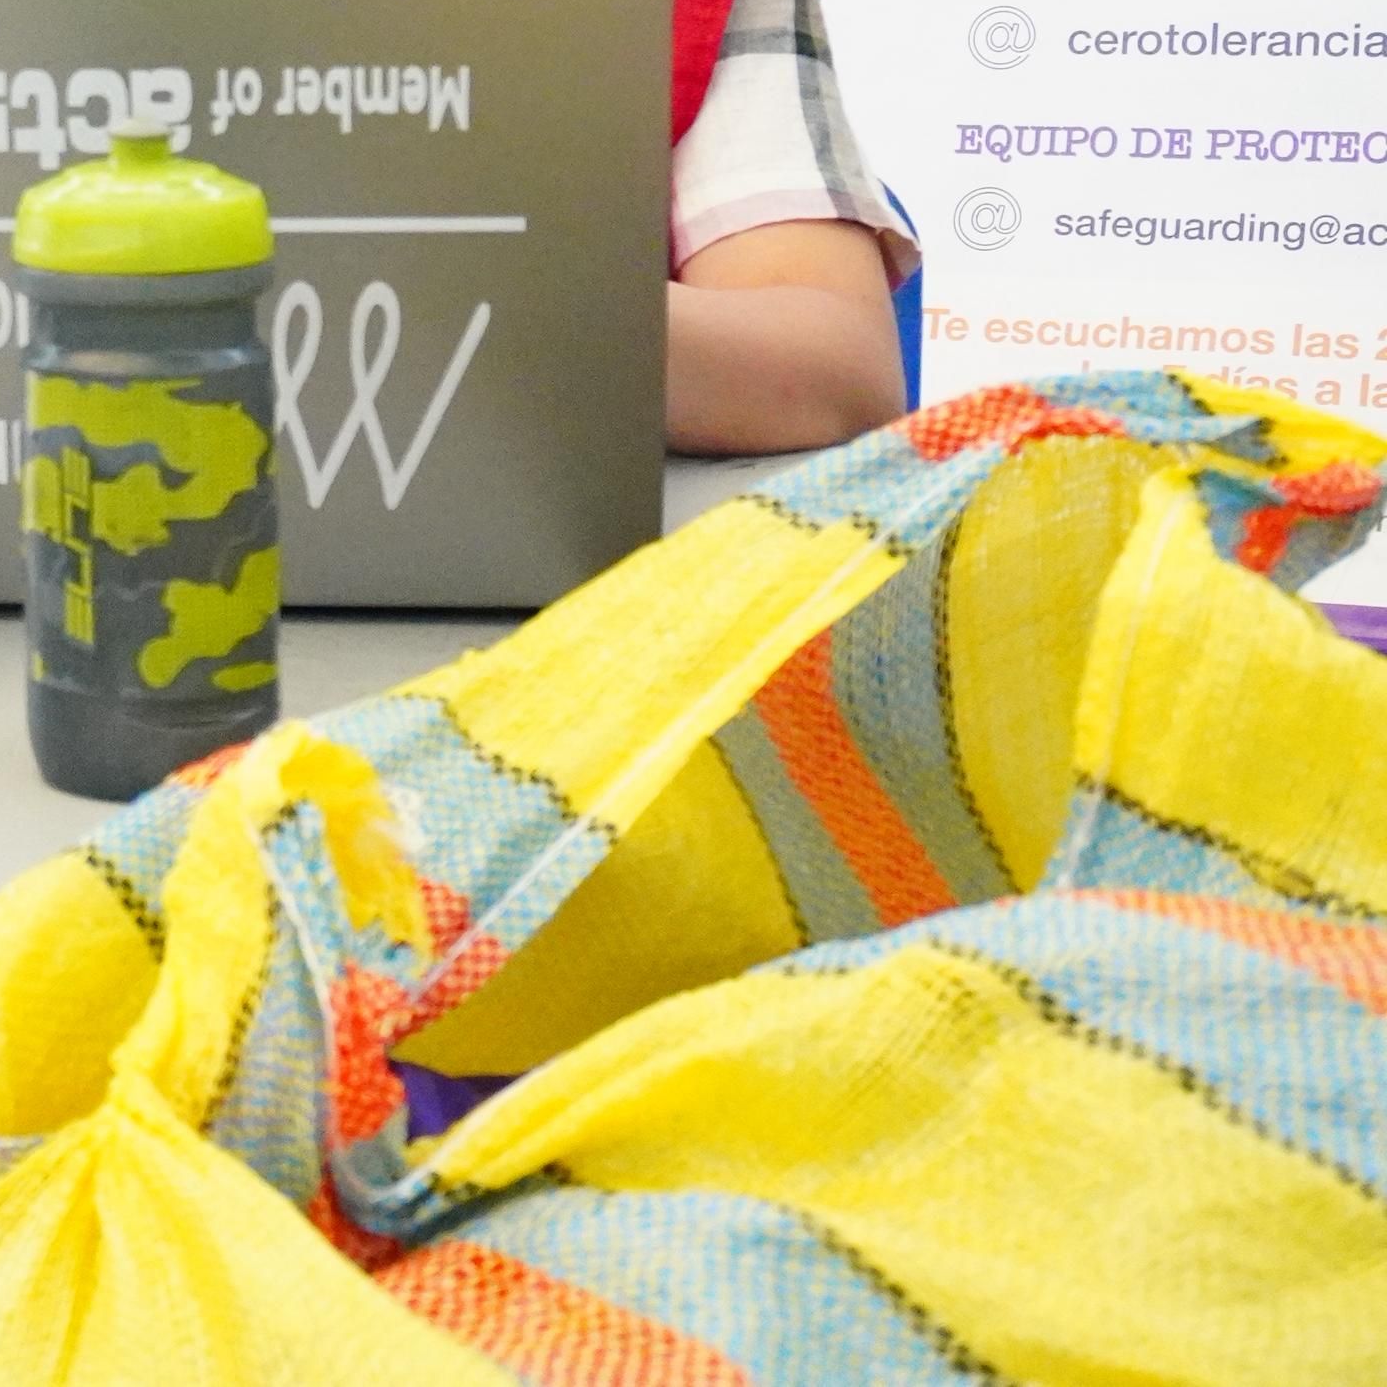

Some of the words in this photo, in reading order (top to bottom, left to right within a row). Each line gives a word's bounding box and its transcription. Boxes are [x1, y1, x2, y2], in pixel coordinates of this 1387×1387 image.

[210, 67, 263, 136] of
[274, 65, 470, 134] Member
[955, 124, 1118, 163] EQUIPO
[1129, 128, 1192, 159] DE
[923, 308, 969, 342] Te
[984, 317, 1275, 356] escuchamos
[1292, 324, 1359, 360] las
[1316, 380, 1341, 405] a
